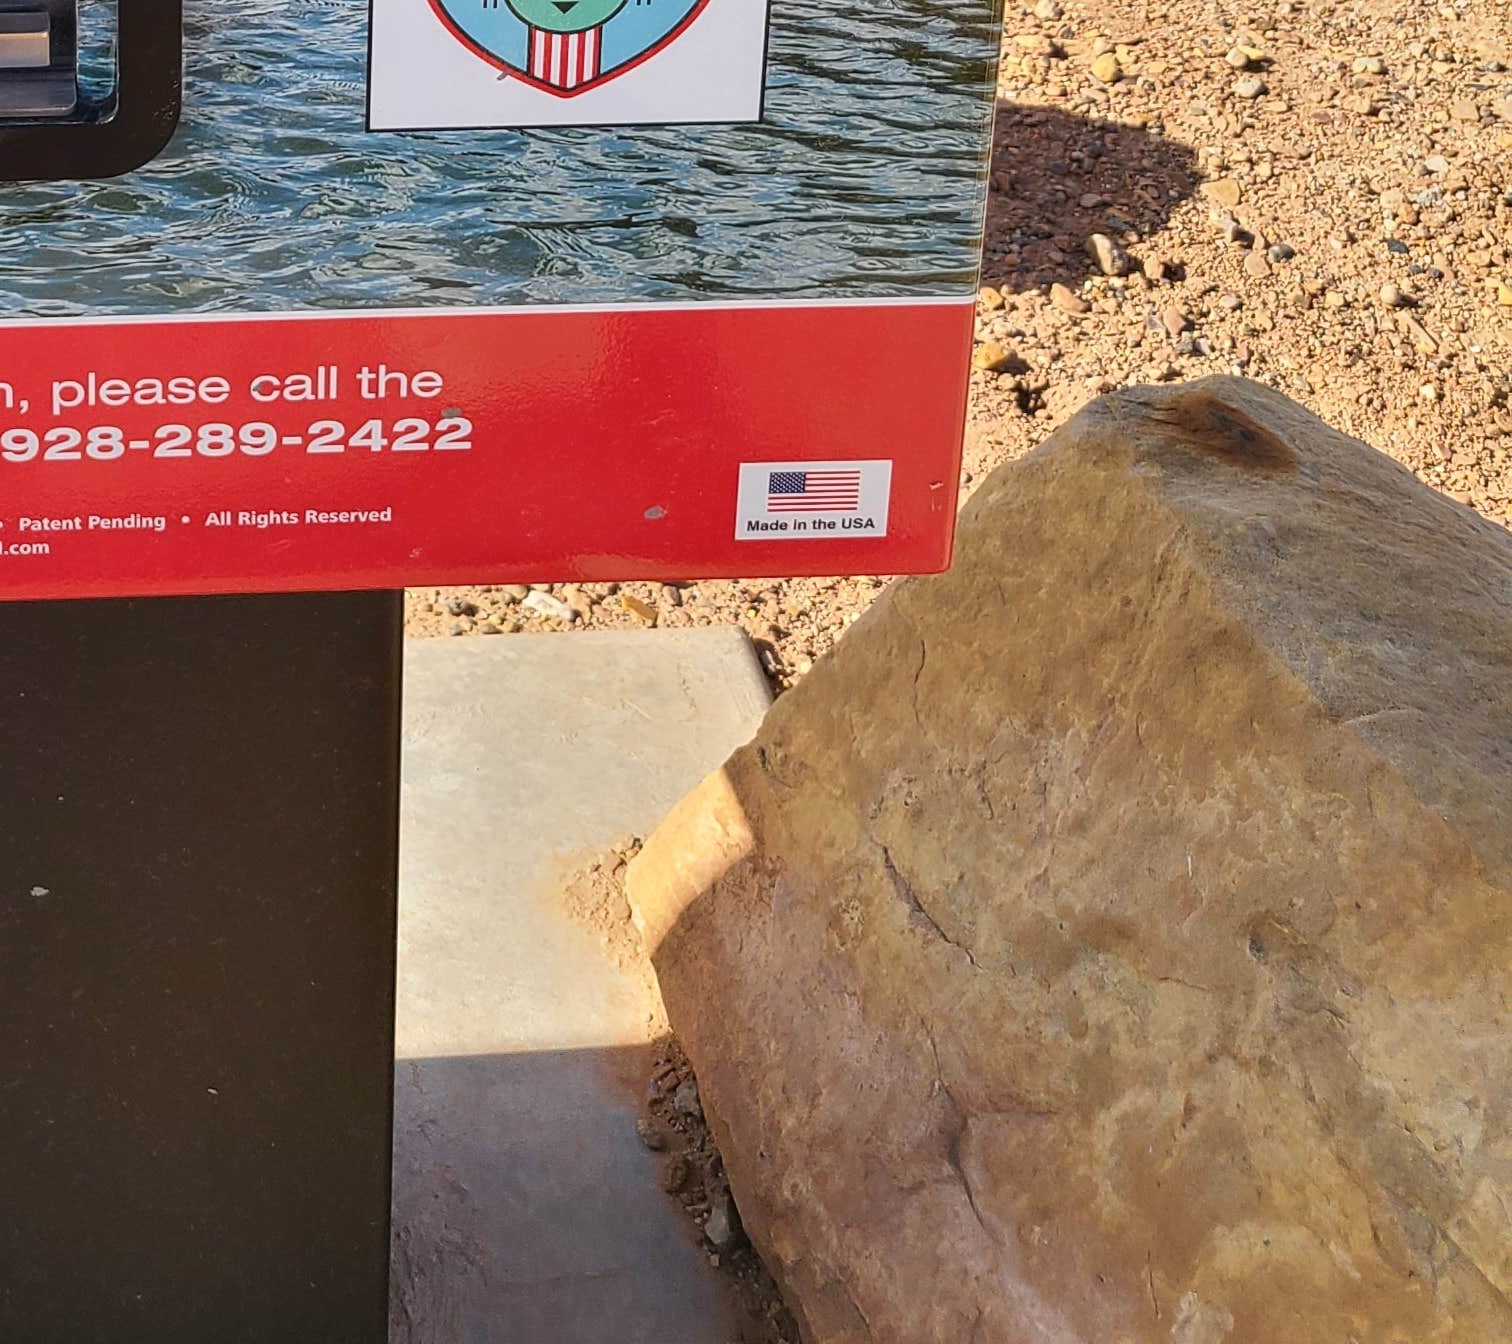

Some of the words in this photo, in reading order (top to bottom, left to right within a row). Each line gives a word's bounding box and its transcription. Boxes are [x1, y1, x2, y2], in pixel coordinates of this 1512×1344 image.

[51, 372, 230, 415] please
[250, 366, 338, 402] call
[356, 364, 443, 398] the
[0, 416, 473, 463] 928-289-2422
[19, 515, 82, 531] Patent
[88, 514, 167, 532] Pending
[205, 511, 232, 527] All
[237, 509, 299, 527] Rights
[305, 507, 392, 524] Reserved
[746, 520, 788, 532] Made
[793, 519, 807, 530] in
[812, 518, 836, 530] the
[841, 517, 875, 529] USA
